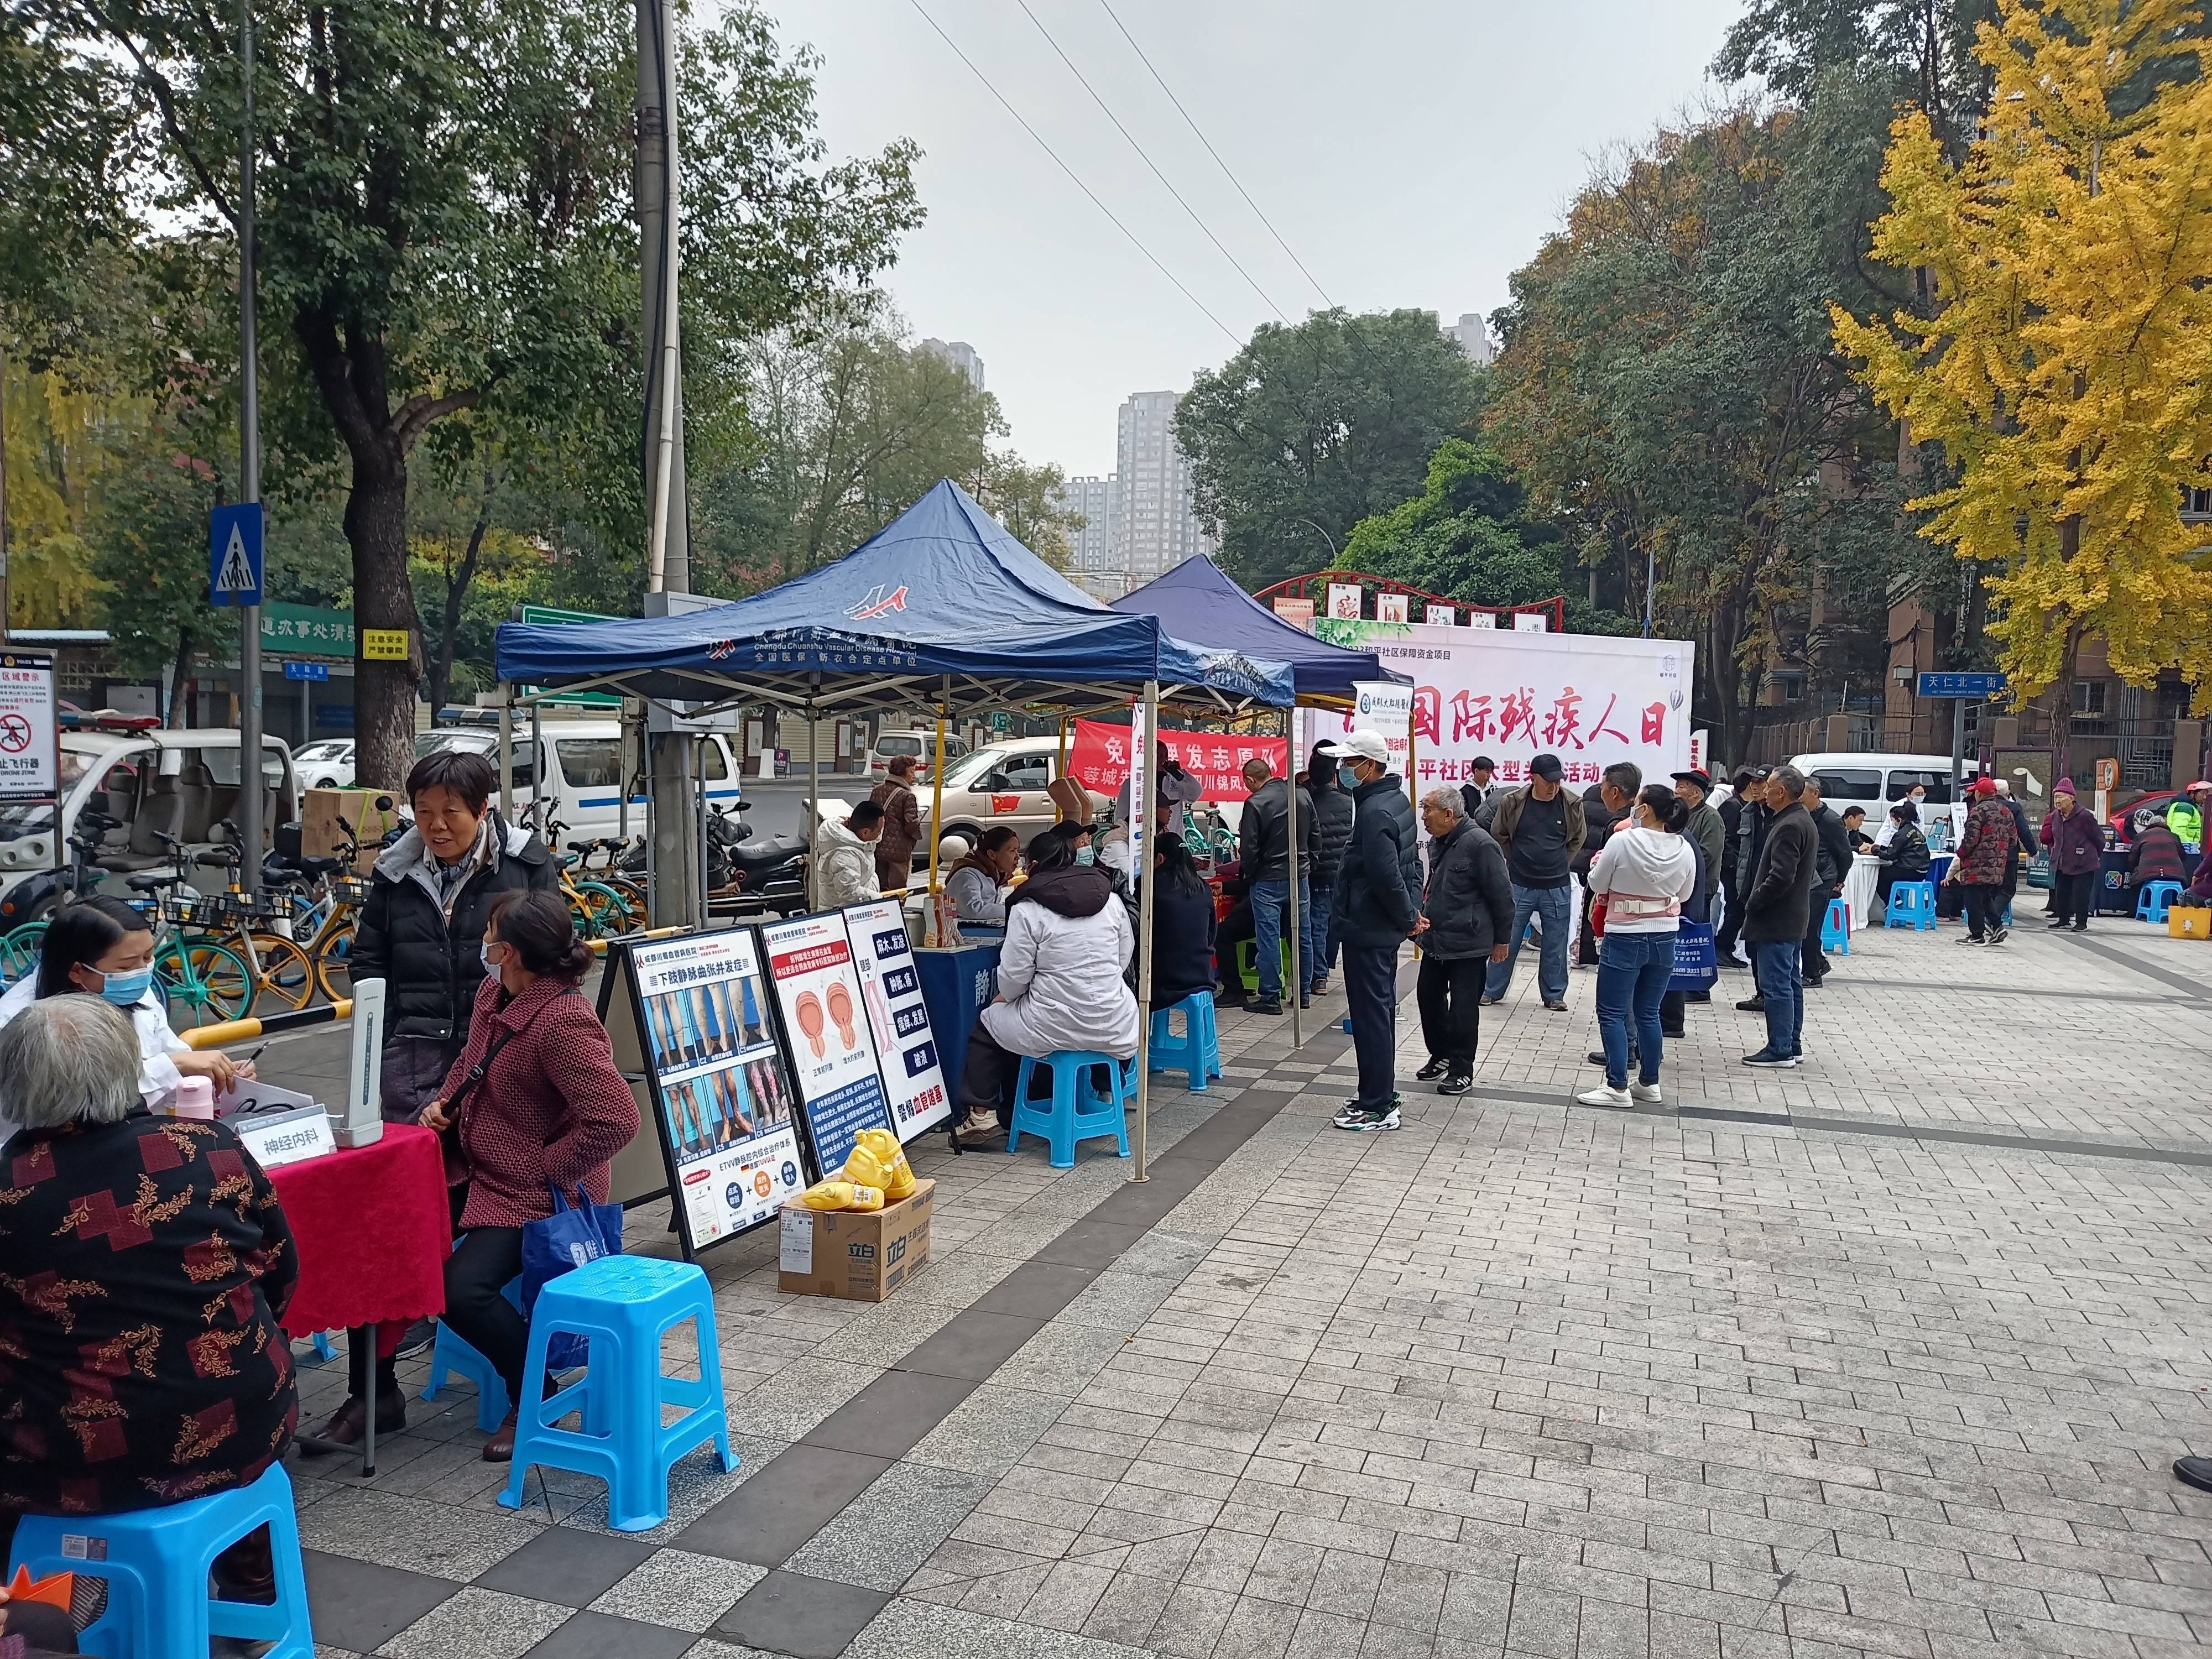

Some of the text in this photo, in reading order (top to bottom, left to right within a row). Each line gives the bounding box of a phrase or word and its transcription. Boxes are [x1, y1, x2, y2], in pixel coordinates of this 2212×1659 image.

[754, 643, 786, 651] Chengdu
[824, 643, 854, 651] Vascular
[855, 644, 885, 653] Disease
[2, 671, 39, 682] 区域警示
[1928, 676, 1997, 688] 天仁北一街
[1343, 686, 1666, 749] 国际残疾人日
[1104, 736, 1278, 773] 免理发志愿队
[876, 934, 906, 954] 麻木、发凉
[658, 958, 743, 986] 下肢静脉曲张并发症
[859, 958, 871, 972] 腿部
[913, 1050, 928, 1068] 破溃
[264, 1128, 319, 1155] 神经内科
[848, 1243, 875, 1258] 立白
[886, 1234, 906, 1268] 立白
